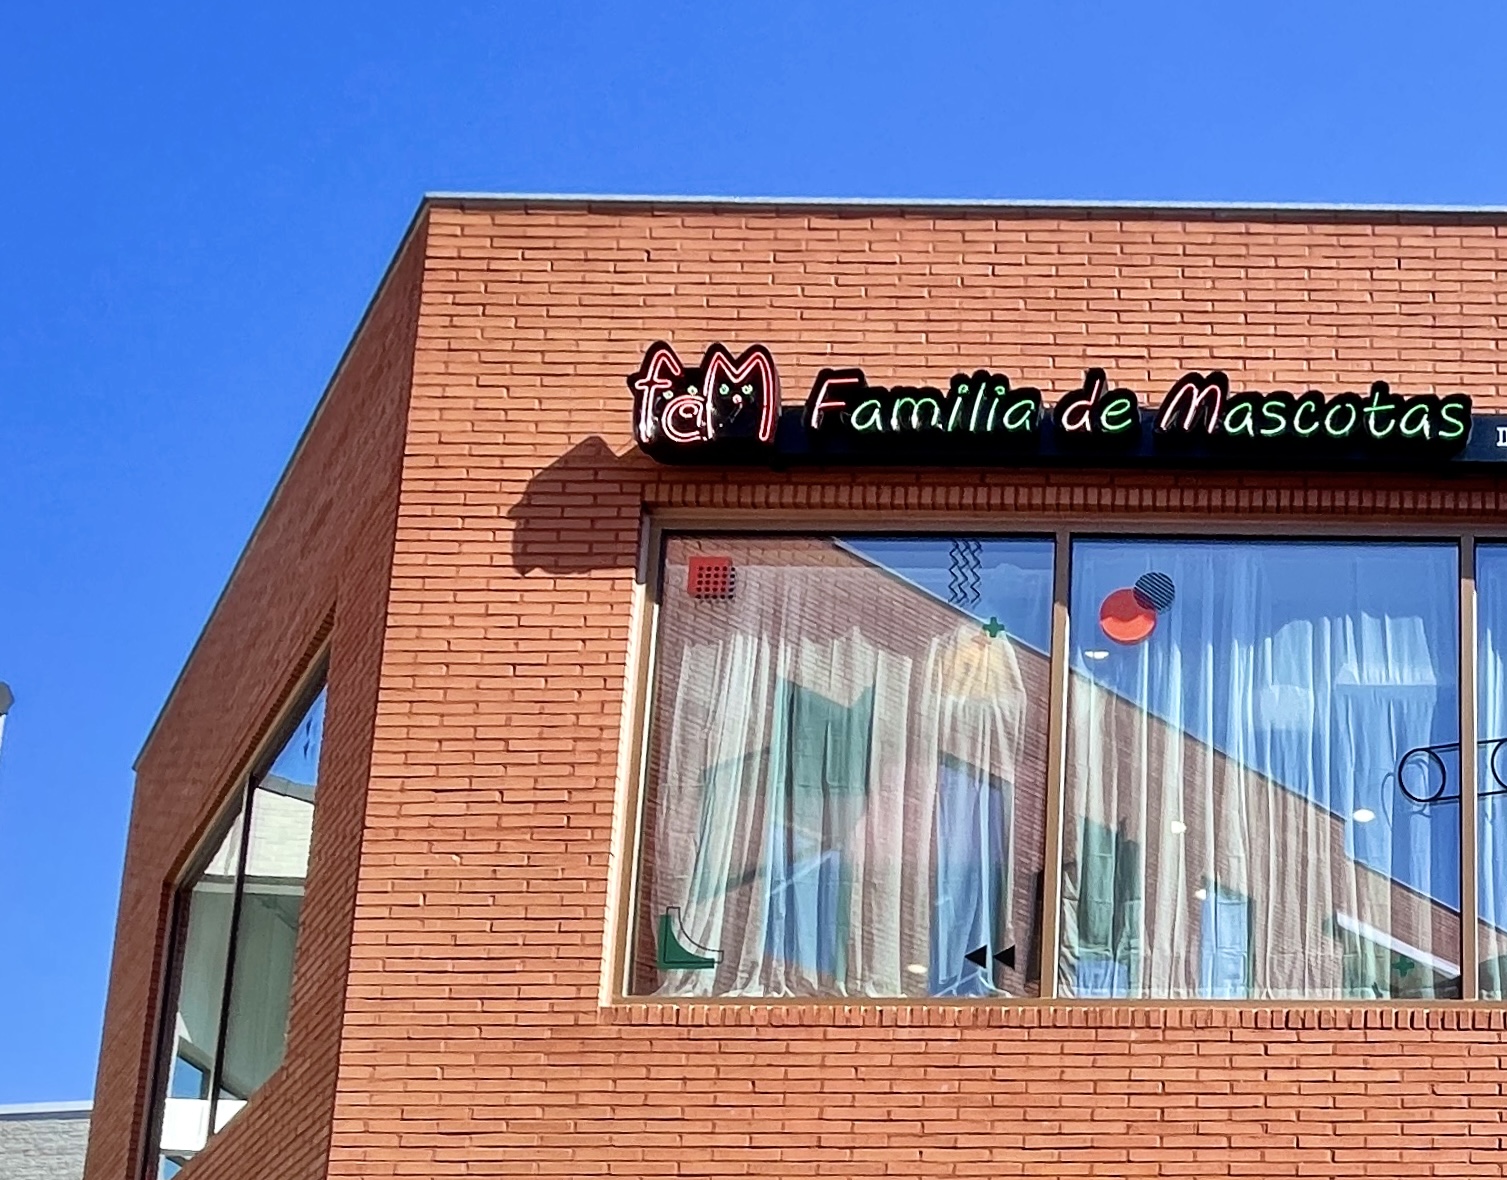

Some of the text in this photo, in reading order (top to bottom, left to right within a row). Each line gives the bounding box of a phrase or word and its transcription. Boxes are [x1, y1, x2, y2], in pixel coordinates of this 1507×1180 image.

[811, 377, 1466, 439] Familia de Mascotas
